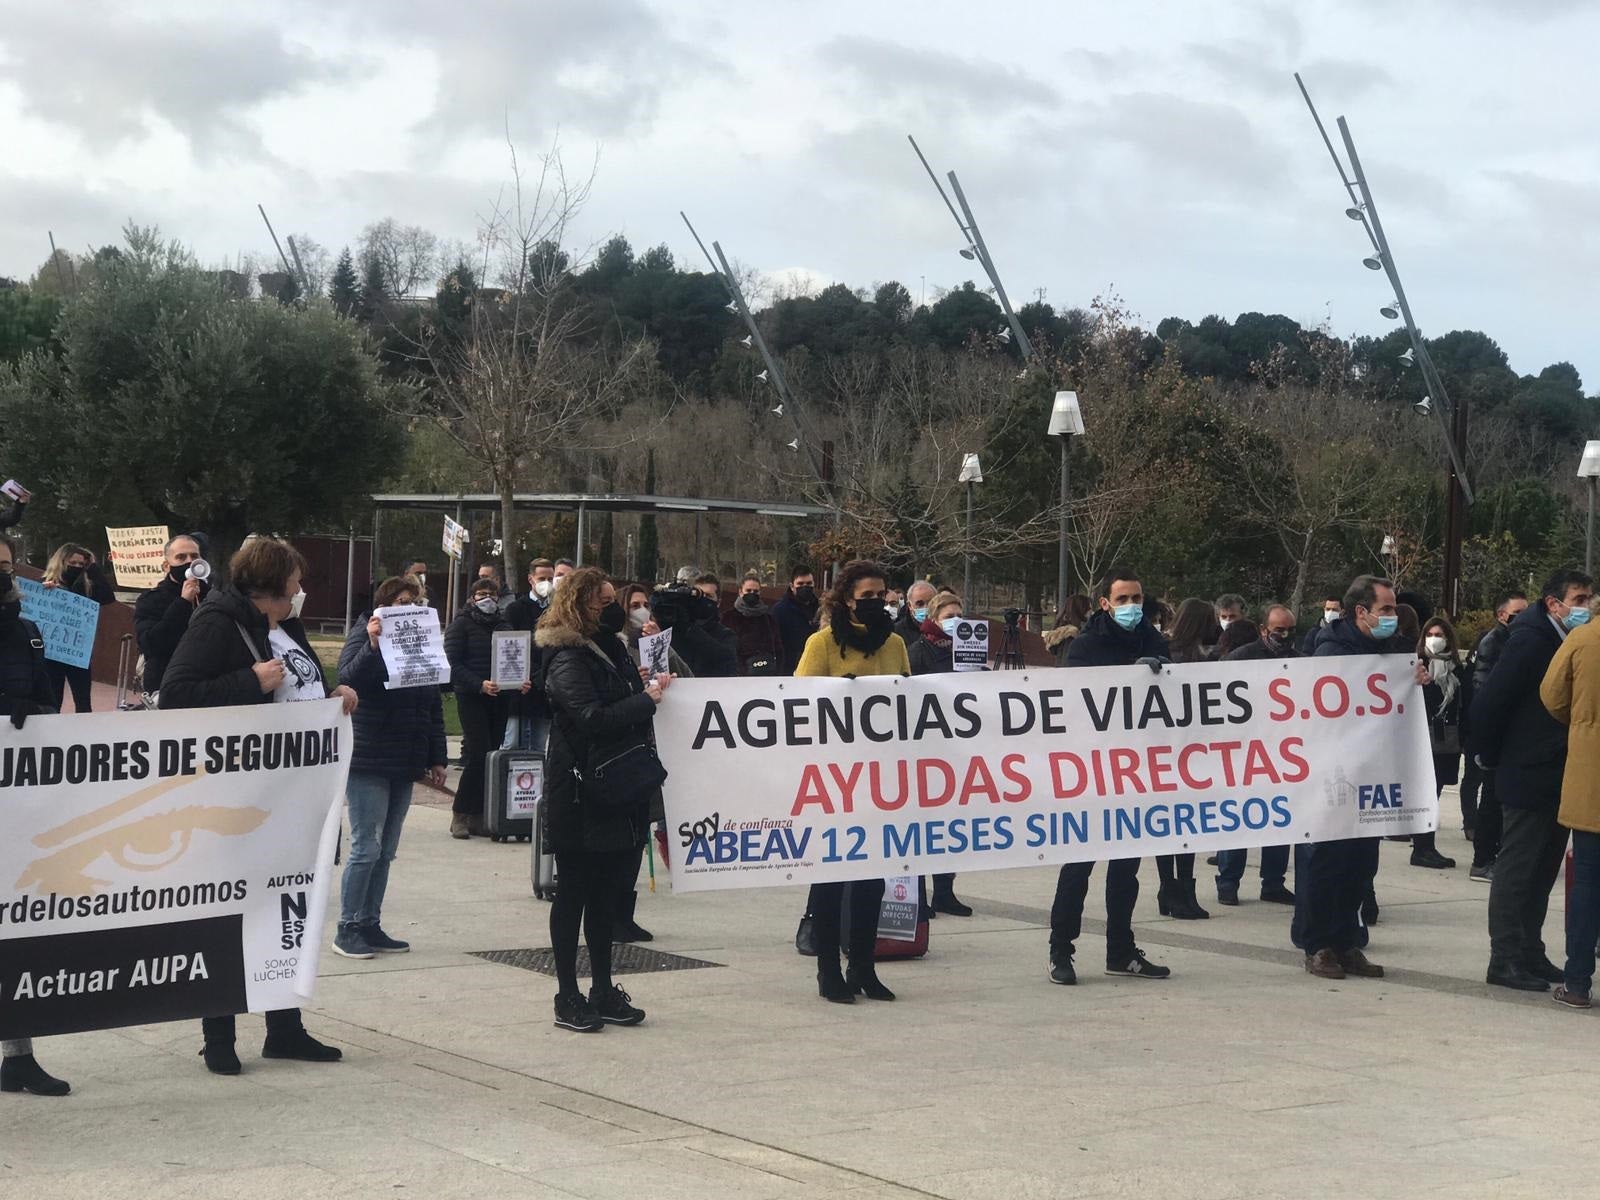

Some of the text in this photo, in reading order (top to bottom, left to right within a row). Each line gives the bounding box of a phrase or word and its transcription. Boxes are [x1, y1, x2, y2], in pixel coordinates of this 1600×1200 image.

[394, 619, 422, 632] S.O.S.
[691, 673, 1405, 750] AGENCIAS DE VIAJES S.O.S.
[0, 726, 340, 788] JADORES DE SEGUNDA!
[790, 736, 1311, 817] AYUDAS DIRECTAS
[1358, 783, 1403, 810] FAE
[723, 819, 737, 831] de
[740, 817, 793, 831] confianza
[821, 795, 1292, 863] 12 MESES SIN INGRESOS
[685, 826, 813, 866] ABEAV
[882, 911, 913, 920] DIRECTAS
[885, 903, 912, 912] AYUDAS
[282, 920, 305, 934] ES
[13, 951, 209, 1002] Actuar AUPA
